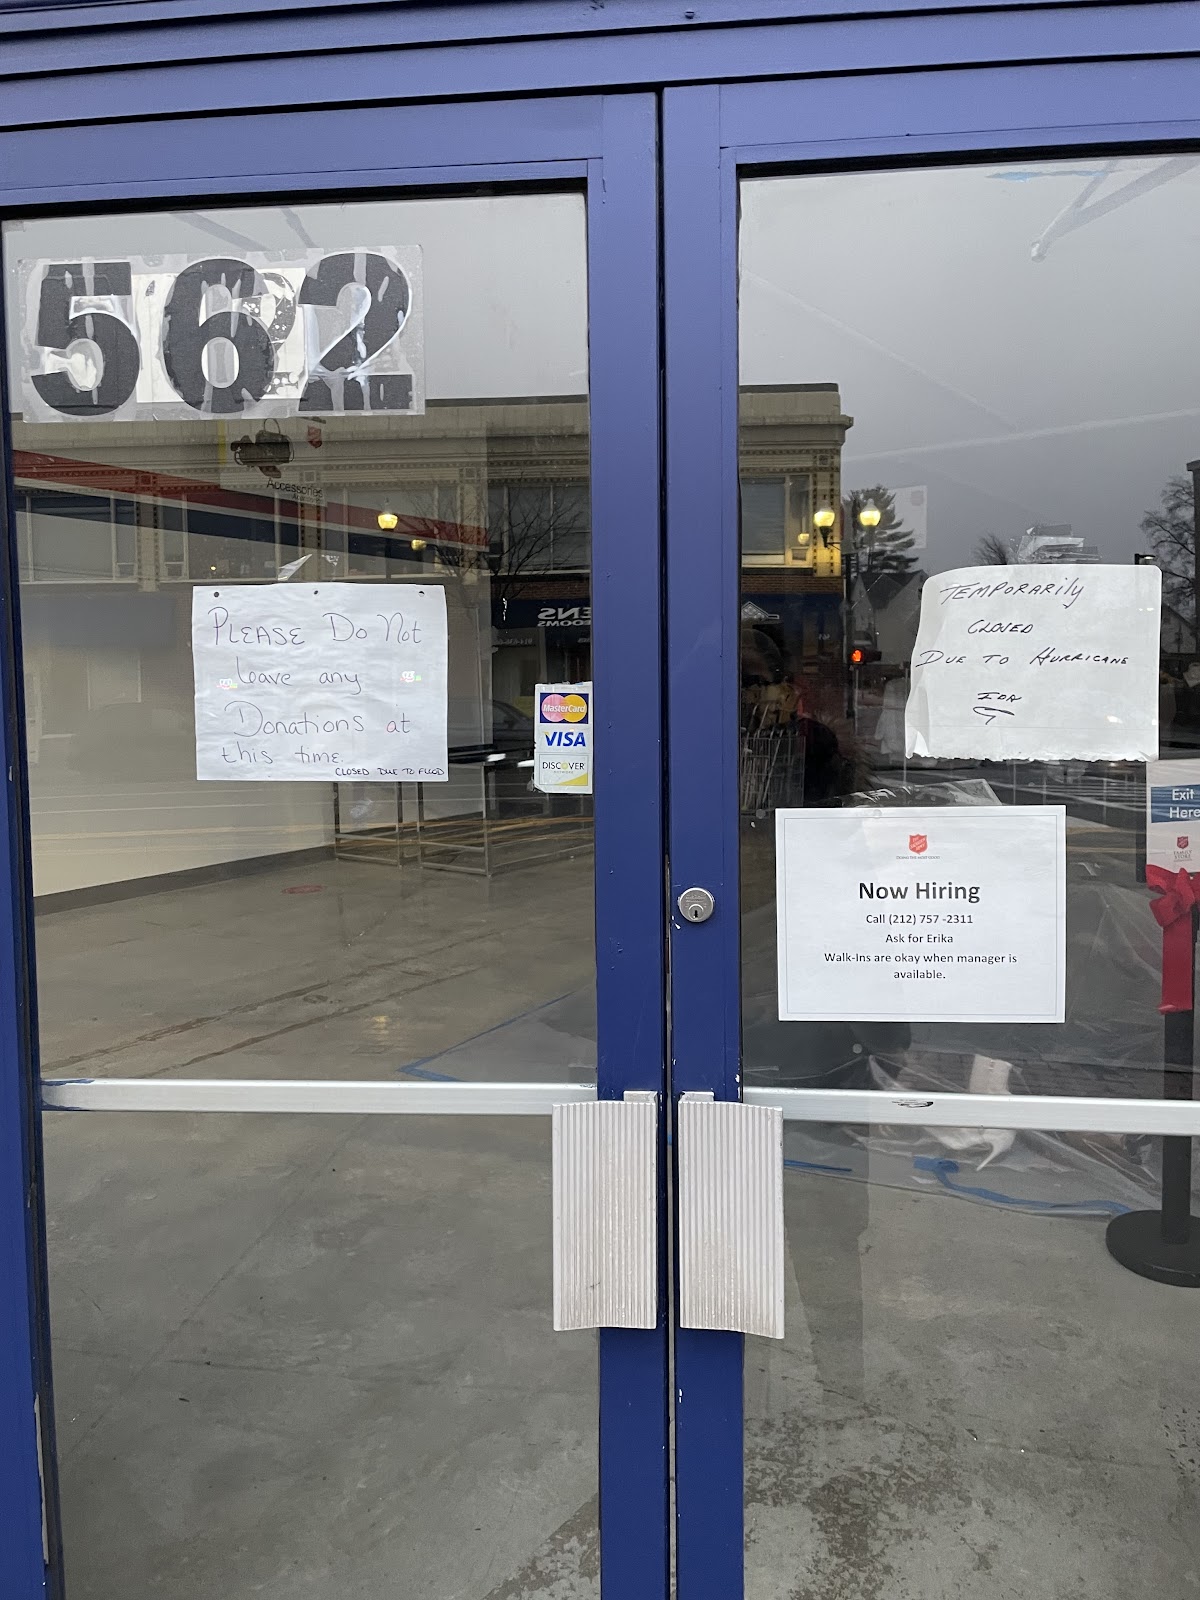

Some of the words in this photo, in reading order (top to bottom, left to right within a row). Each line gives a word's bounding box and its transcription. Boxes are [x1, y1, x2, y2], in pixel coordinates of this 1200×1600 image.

[31, 252, 413, 416] 562
[265, 478, 324, 499] Accessories
[207, 606, 306, 646] PLEASE
[322, 612, 368, 642] Do
[376, 612, 423, 644] Not
[967, 619, 1034, 635] CLOSED
[318, 671, 363, 696] any
[543, 704, 587, 714] MasterCard
[223, 700, 365, 738] Donations
[386, 712, 411, 734] at
[543, 731, 587, 748] VISA
[221, 741, 274, 765] this
[335, 767, 370, 777] CLOSED
[541, 761, 585, 771] DISCOVER
[1171, 788, 1195, 801] Exit
[1169, 806, 1200, 819] Here
[859, 882, 909, 900] Now
[915, 881, 981, 904] Hiring
[865, 914, 886, 924] Call
[888, 914, 917, 926] (212)
[919, 914, 939, 924] 757
[942, 914, 974, 924] -2311
[885, 933, 905, 943] Ask
[907, 933, 924, 943] for
[926, 933, 954, 943] Erika
[824, 952, 871, 962] Walk-Ins
[873, 954, 892, 962] are
[894, 952, 921, 965] okay
[923, 952, 954, 963] when
[956, 955, 1006, 965] manager
[1008, 952, 1018, 963] is
[893, 968, 946, 979] available.
